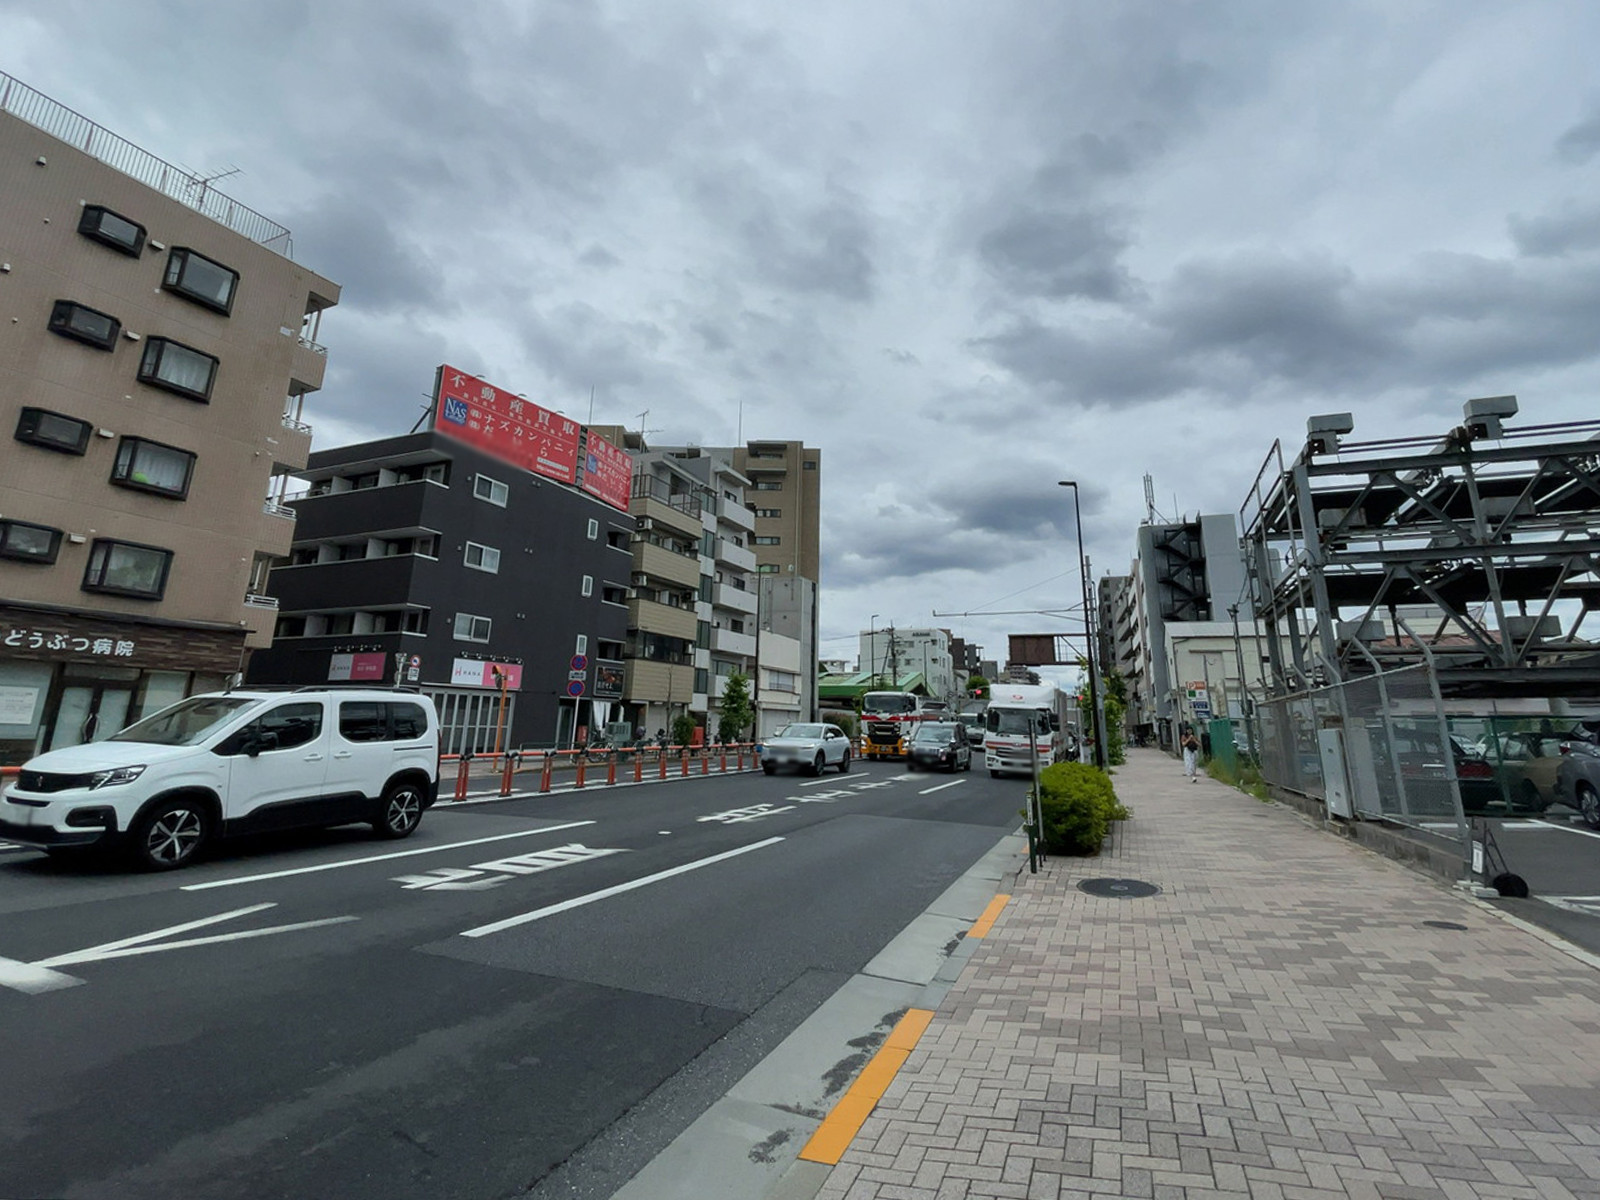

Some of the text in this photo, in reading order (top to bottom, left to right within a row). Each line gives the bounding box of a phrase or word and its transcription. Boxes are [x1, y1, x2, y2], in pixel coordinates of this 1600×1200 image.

[446, 397, 467, 419] NAS
[450, 372, 575, 436] 不動産買取
[4, 630, 135, 656] どうぶつ病院
